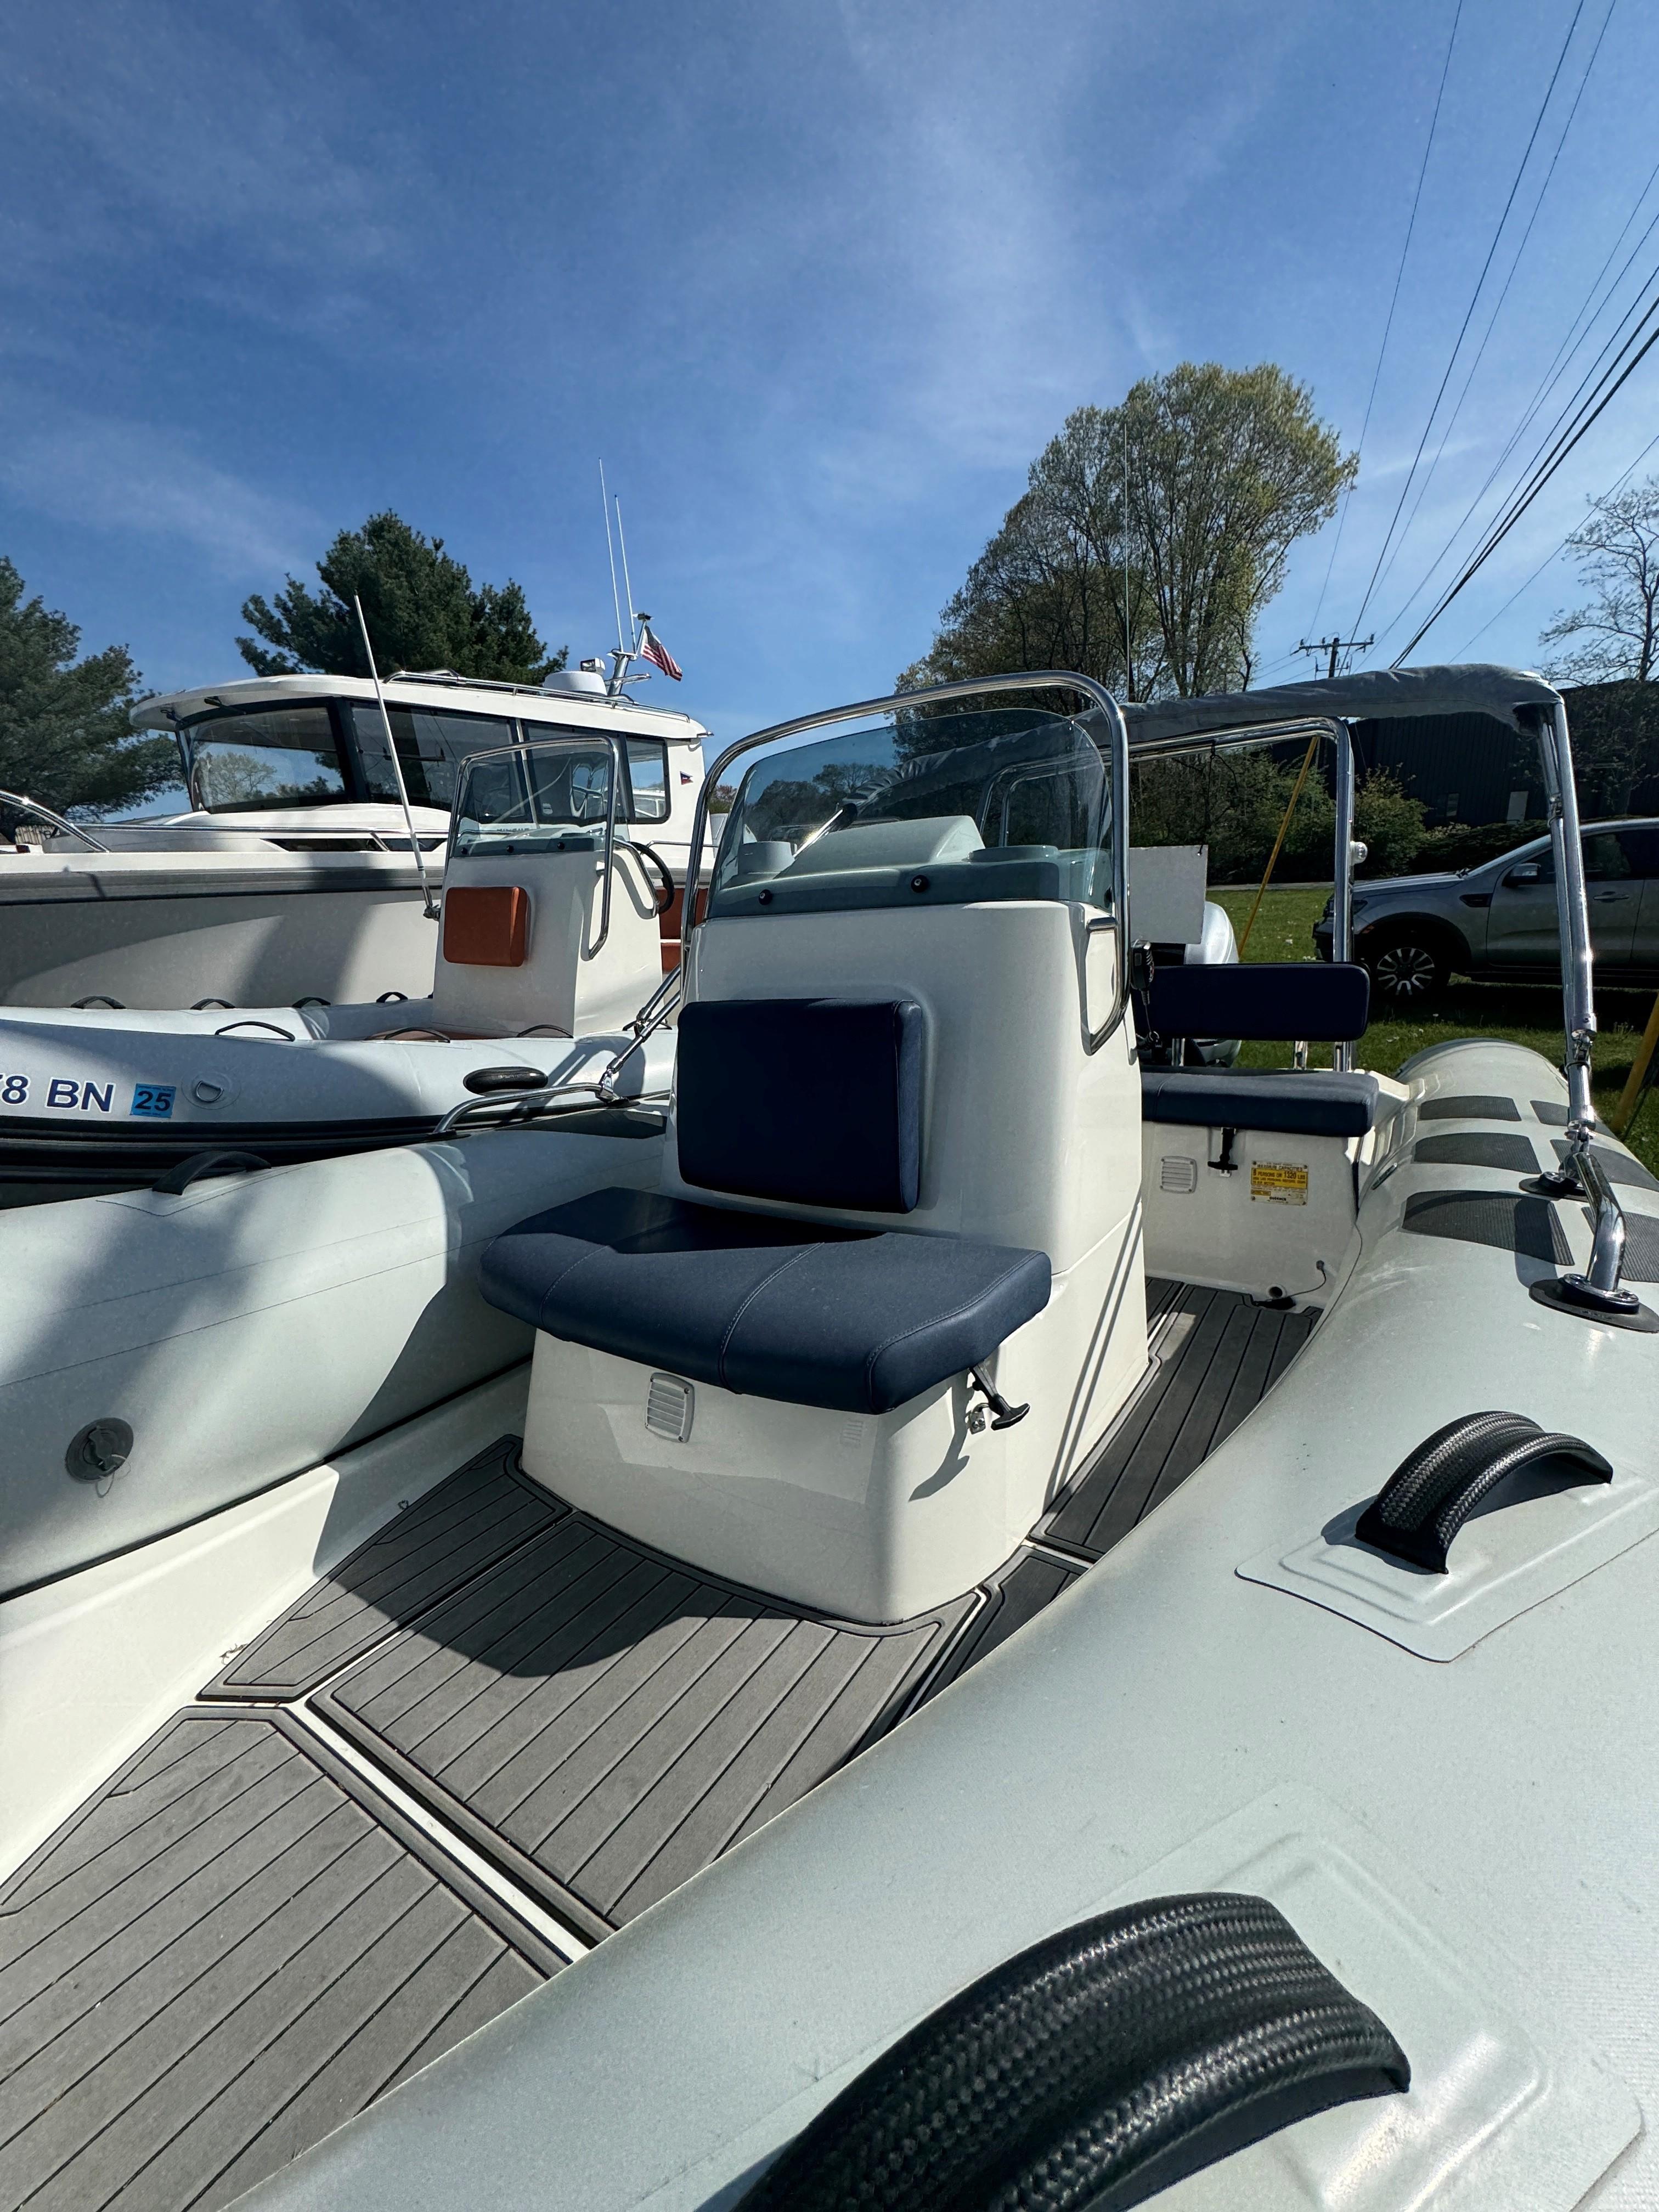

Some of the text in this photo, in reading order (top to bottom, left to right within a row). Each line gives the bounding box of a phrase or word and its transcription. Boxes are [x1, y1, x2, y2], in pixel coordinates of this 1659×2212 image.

[0, 1074, 115, 1113] 8 BN
[134, 1090, 171, 1111] 25
[1284, 1171, 1296, 1179] 1320
